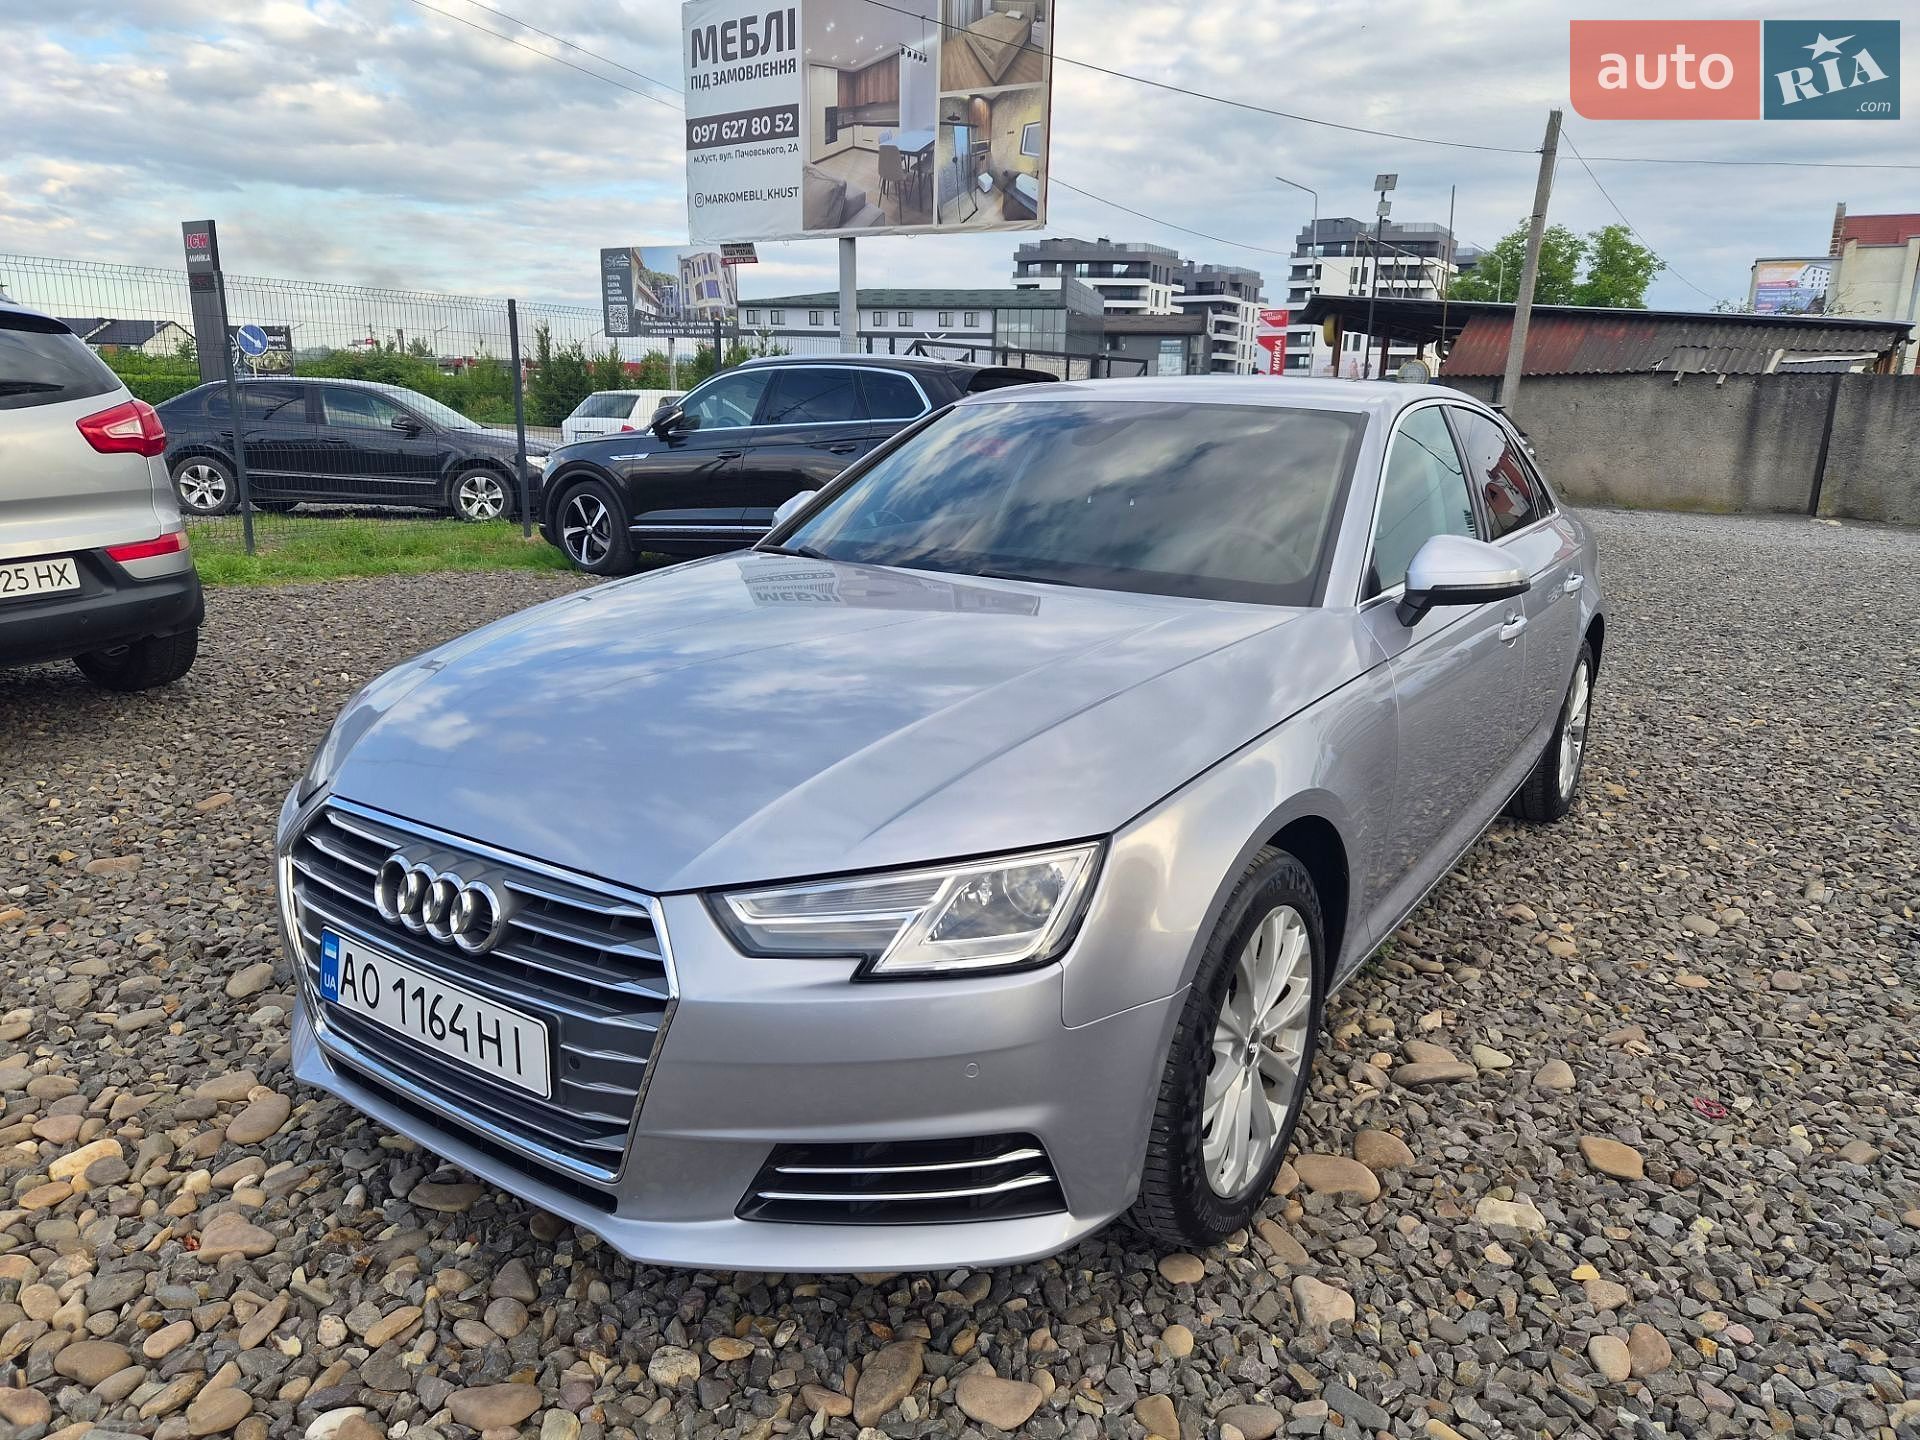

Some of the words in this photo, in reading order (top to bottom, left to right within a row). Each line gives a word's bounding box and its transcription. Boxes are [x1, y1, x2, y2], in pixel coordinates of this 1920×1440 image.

[691, 8, 796, 69] МЕБЛІ
[691, 74, 711, 91] ПІД
[712, 58, 796, 86] ЗАМОВЛЕННЯ
[692, 124, 718, 143] 097
[721, 119, 748, 139] 627
[751, 116, 771, 136] 80
[774, 113, 794, 132] 52
[704, 187, 799, 205] MARKOMEBLI_KHUST
[1272, 339, 1282, 371] МИЙКА
[34, 563, 73, 589] HX
[323, 972, 337, 991] UA
[340, 952, 380, 1009] AO
